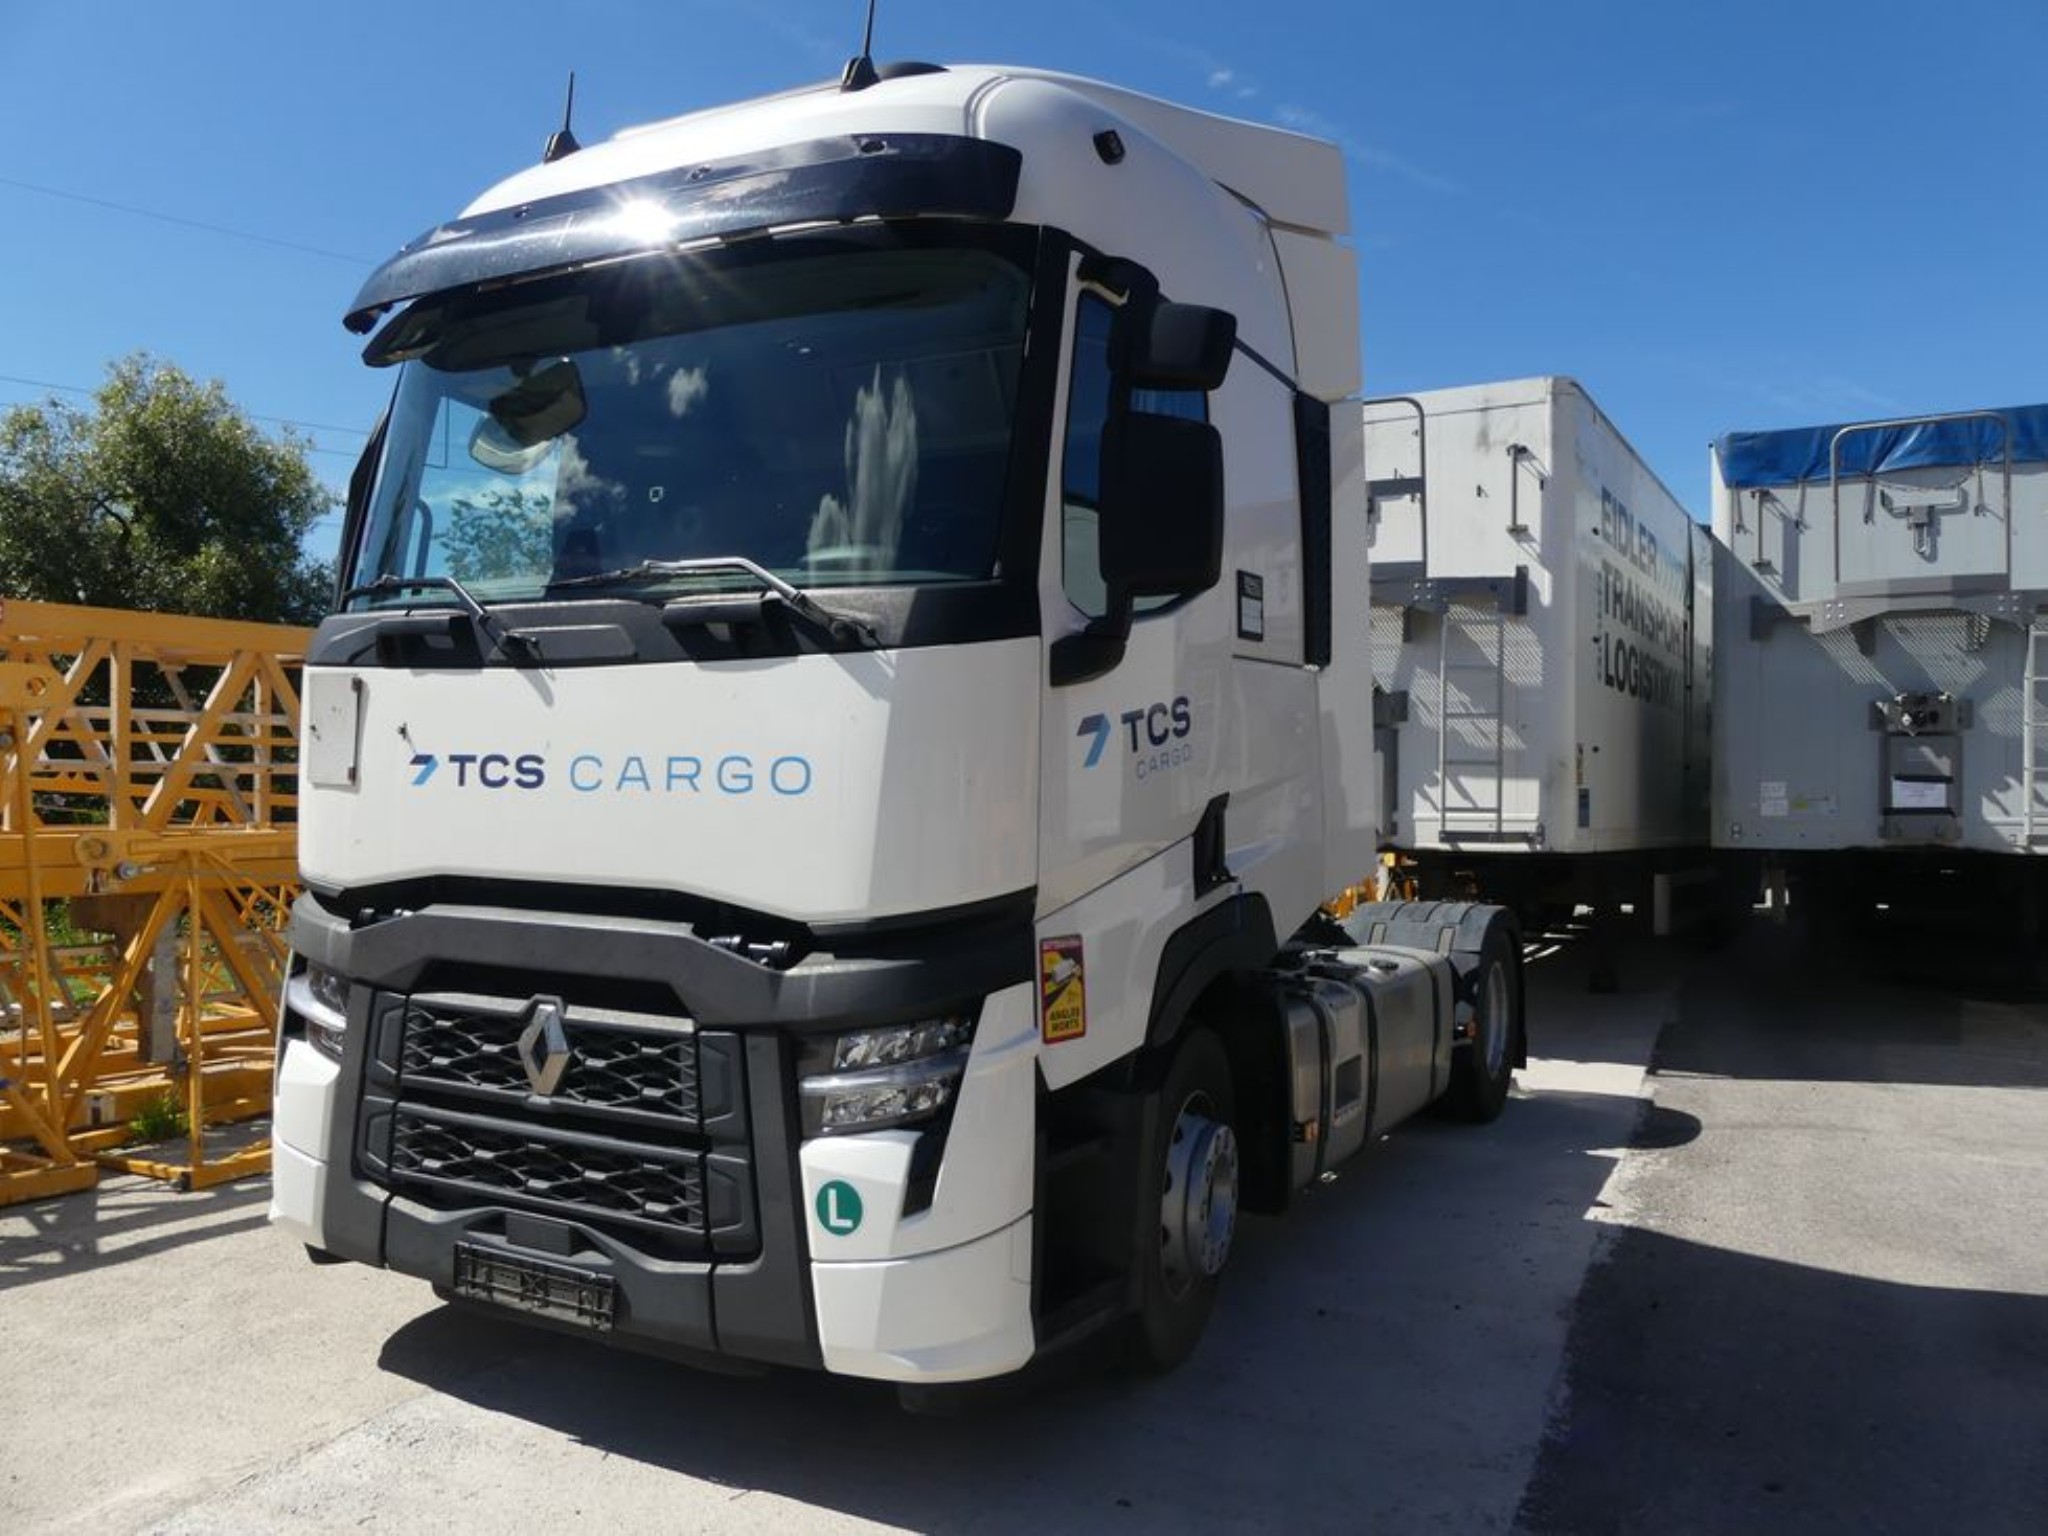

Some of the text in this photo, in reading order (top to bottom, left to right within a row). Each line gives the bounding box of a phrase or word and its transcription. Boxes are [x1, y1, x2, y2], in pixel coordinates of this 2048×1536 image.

[1601, 485, 1657, 581] EIDLER
[1602, 558, 1682, 657] TRANSPOR
[1120, 696, 1191, 753] TCS
[448, 753, 813, 796] TCS CARGO
[1135, 743, 1192, 779] CARGO
[1049, 1005, 1080, 1021] ANGLES
[1051, 1017, 1080, 1032] MORTS
[827, 1187, 854, 1229] L
